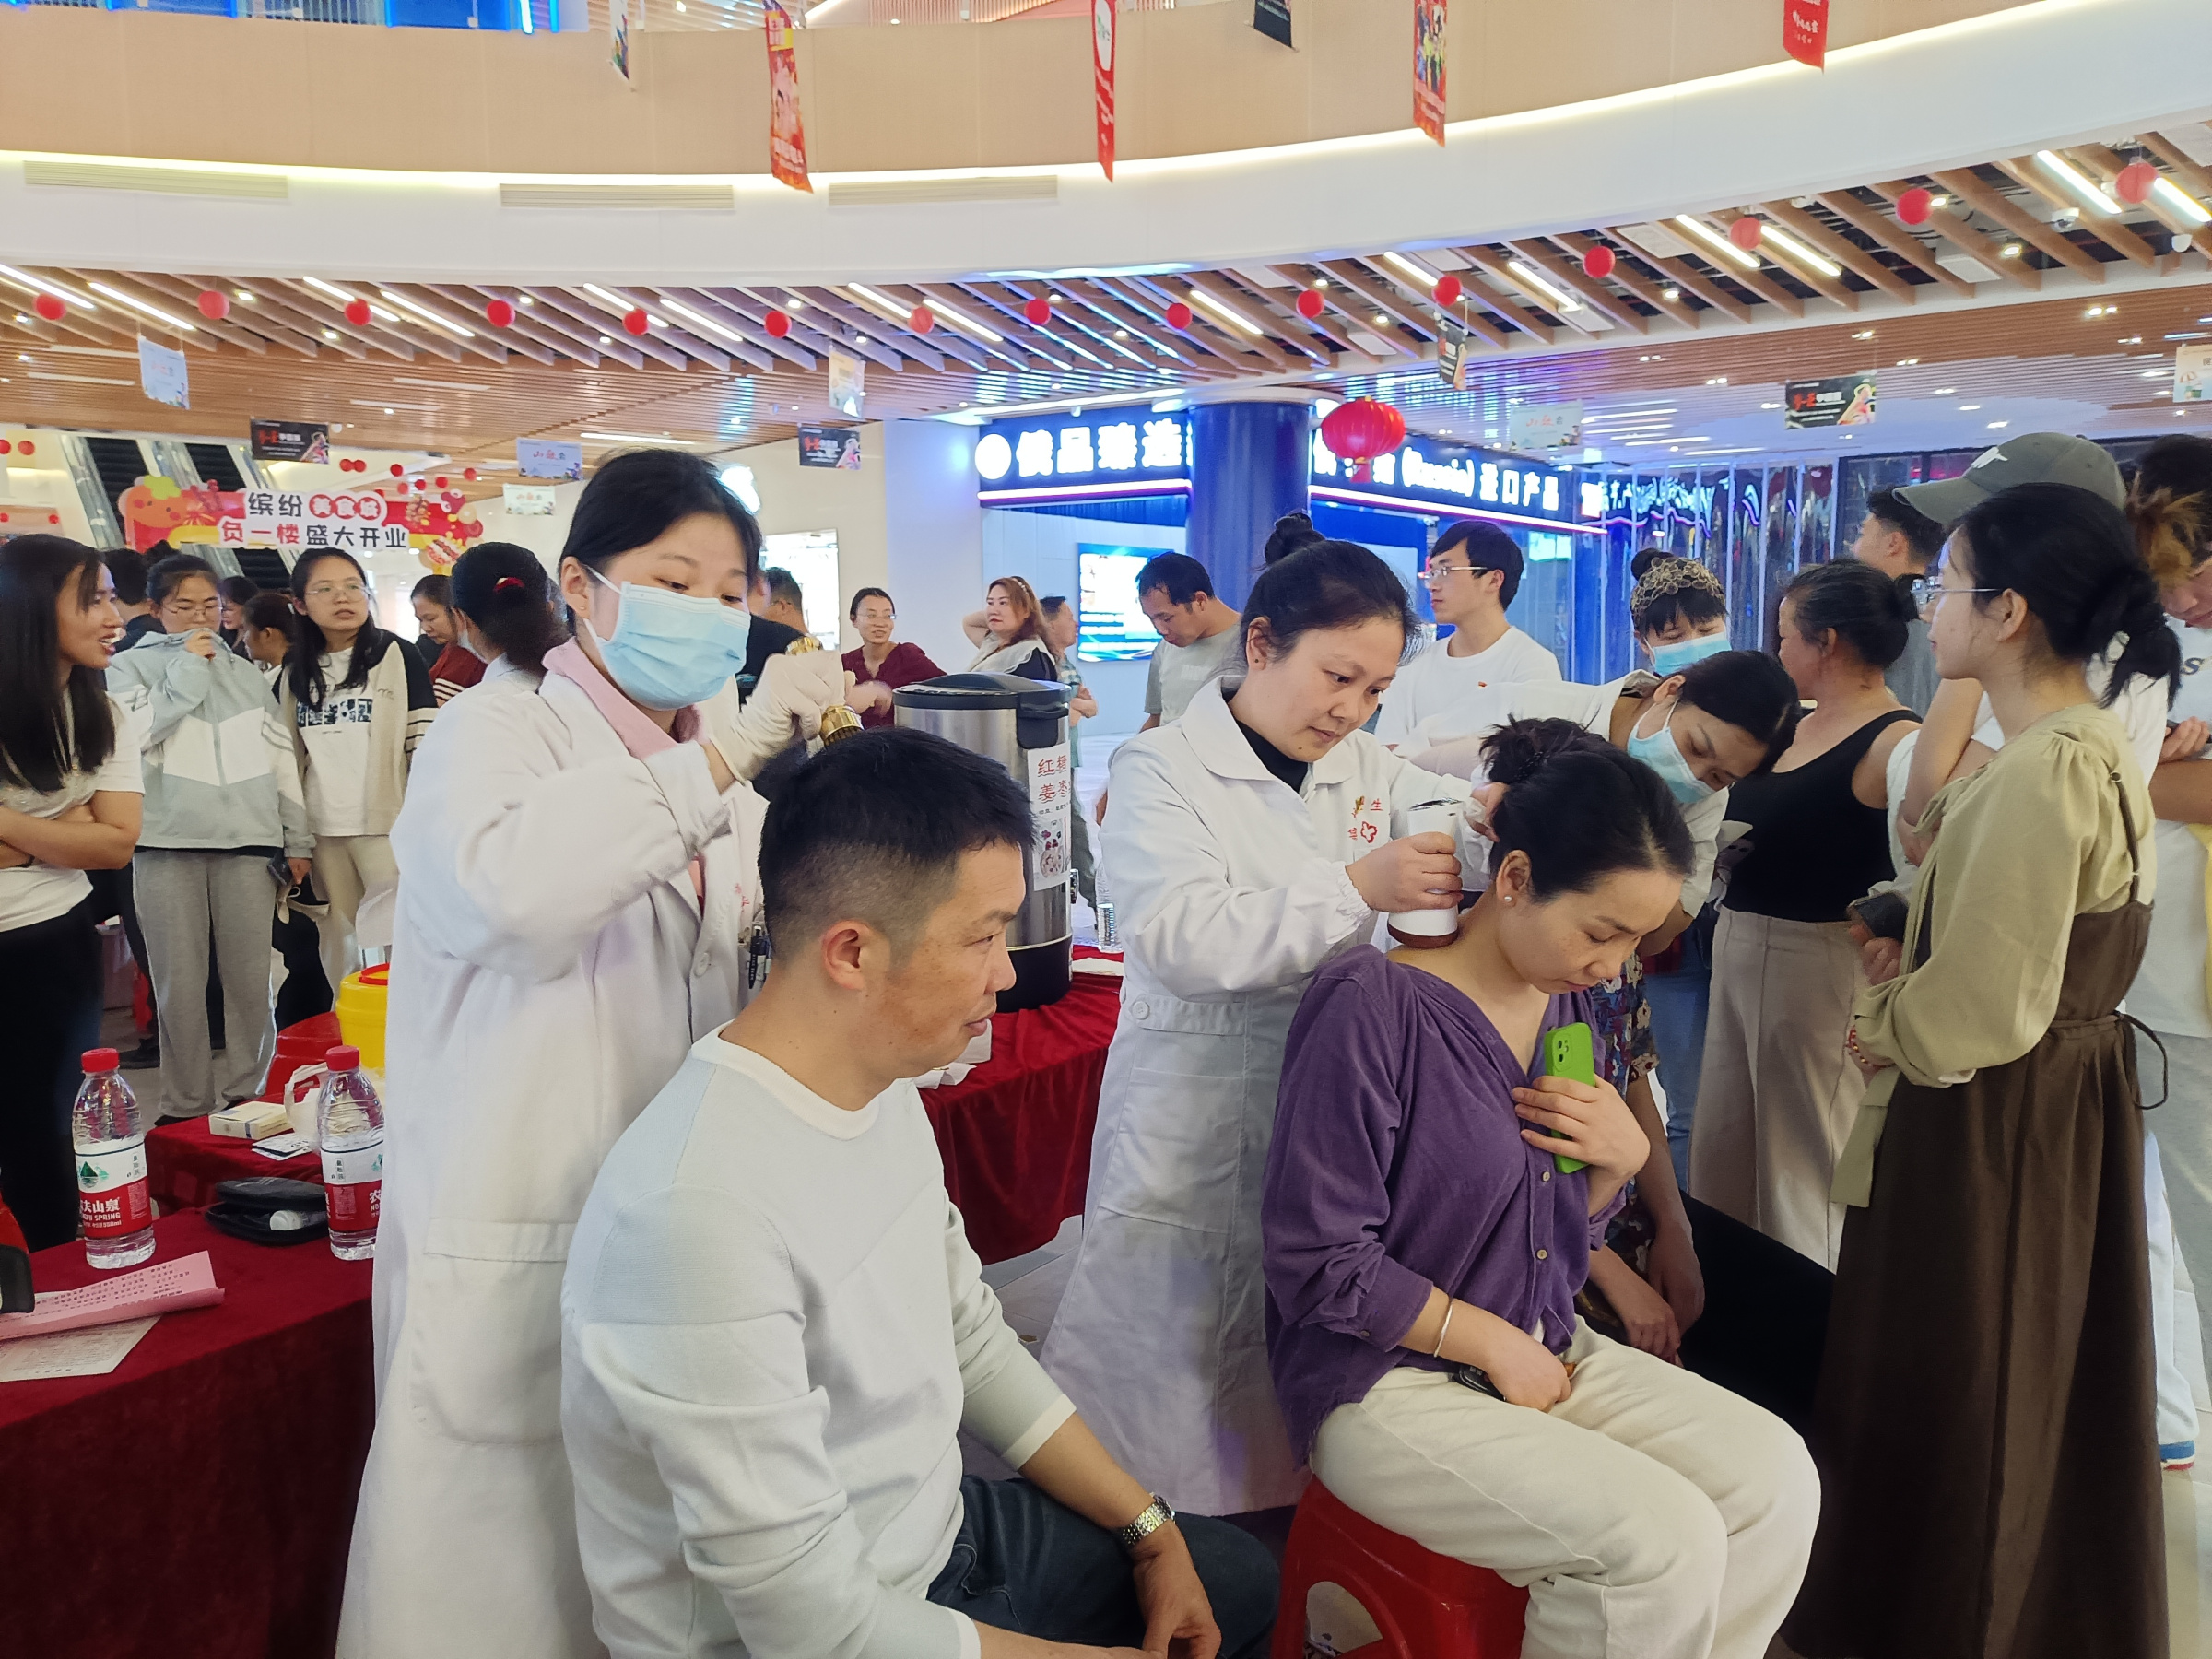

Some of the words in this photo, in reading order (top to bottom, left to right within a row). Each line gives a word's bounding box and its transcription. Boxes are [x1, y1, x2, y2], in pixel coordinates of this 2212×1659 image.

[221, 521, 406, 547] 负一楼盛大开业
[1038, 779, 1070, 803] 姜枣
[94, 1212, 121, 1221] SPRING
